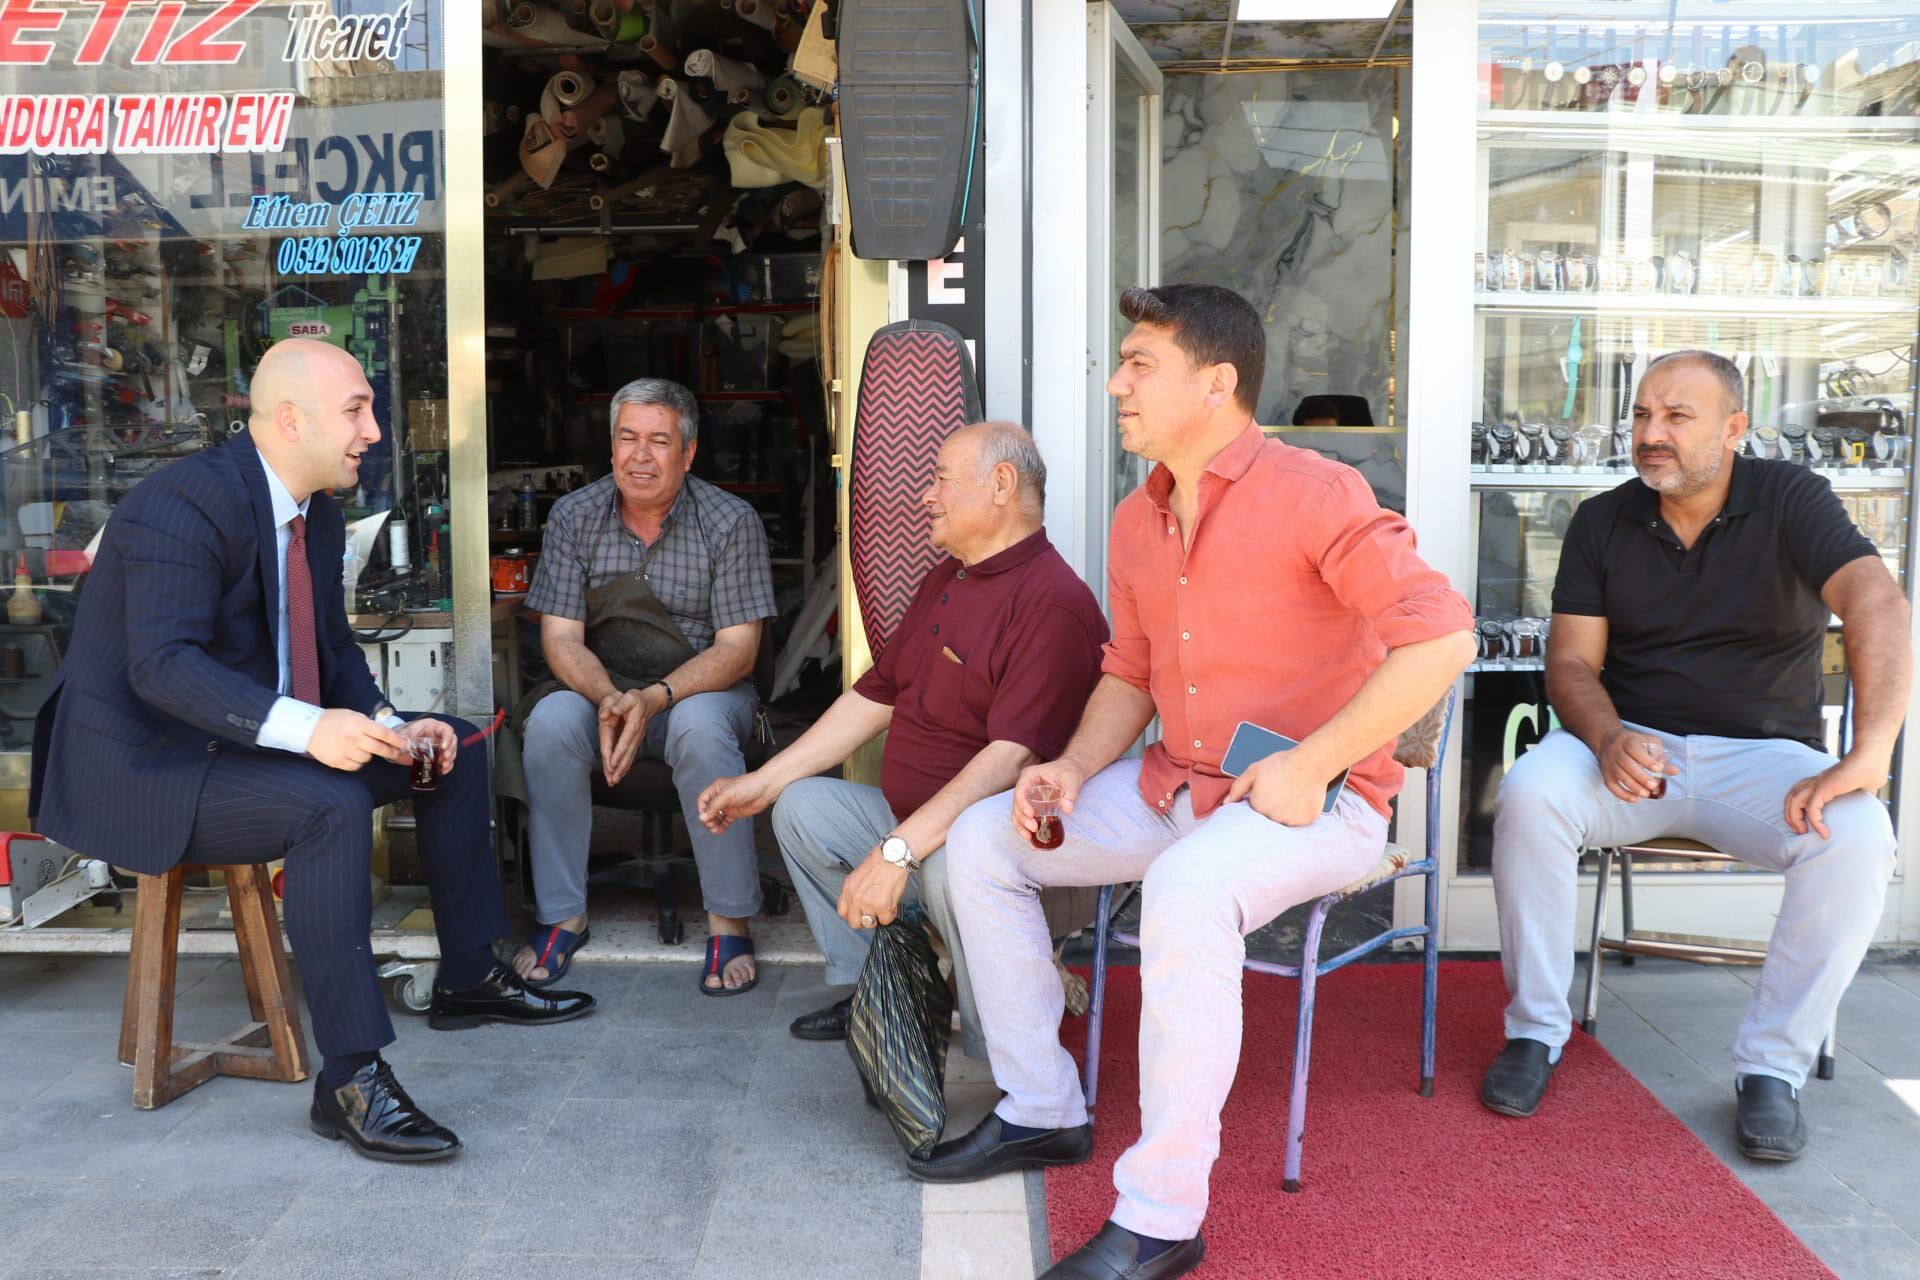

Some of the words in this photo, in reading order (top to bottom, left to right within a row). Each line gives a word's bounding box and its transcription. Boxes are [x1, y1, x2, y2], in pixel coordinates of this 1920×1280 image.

[282, 0, 413, 62] Ticaret
[243, 195, 331, 229] Ethem
[291, 325, 328, 335] SABA
